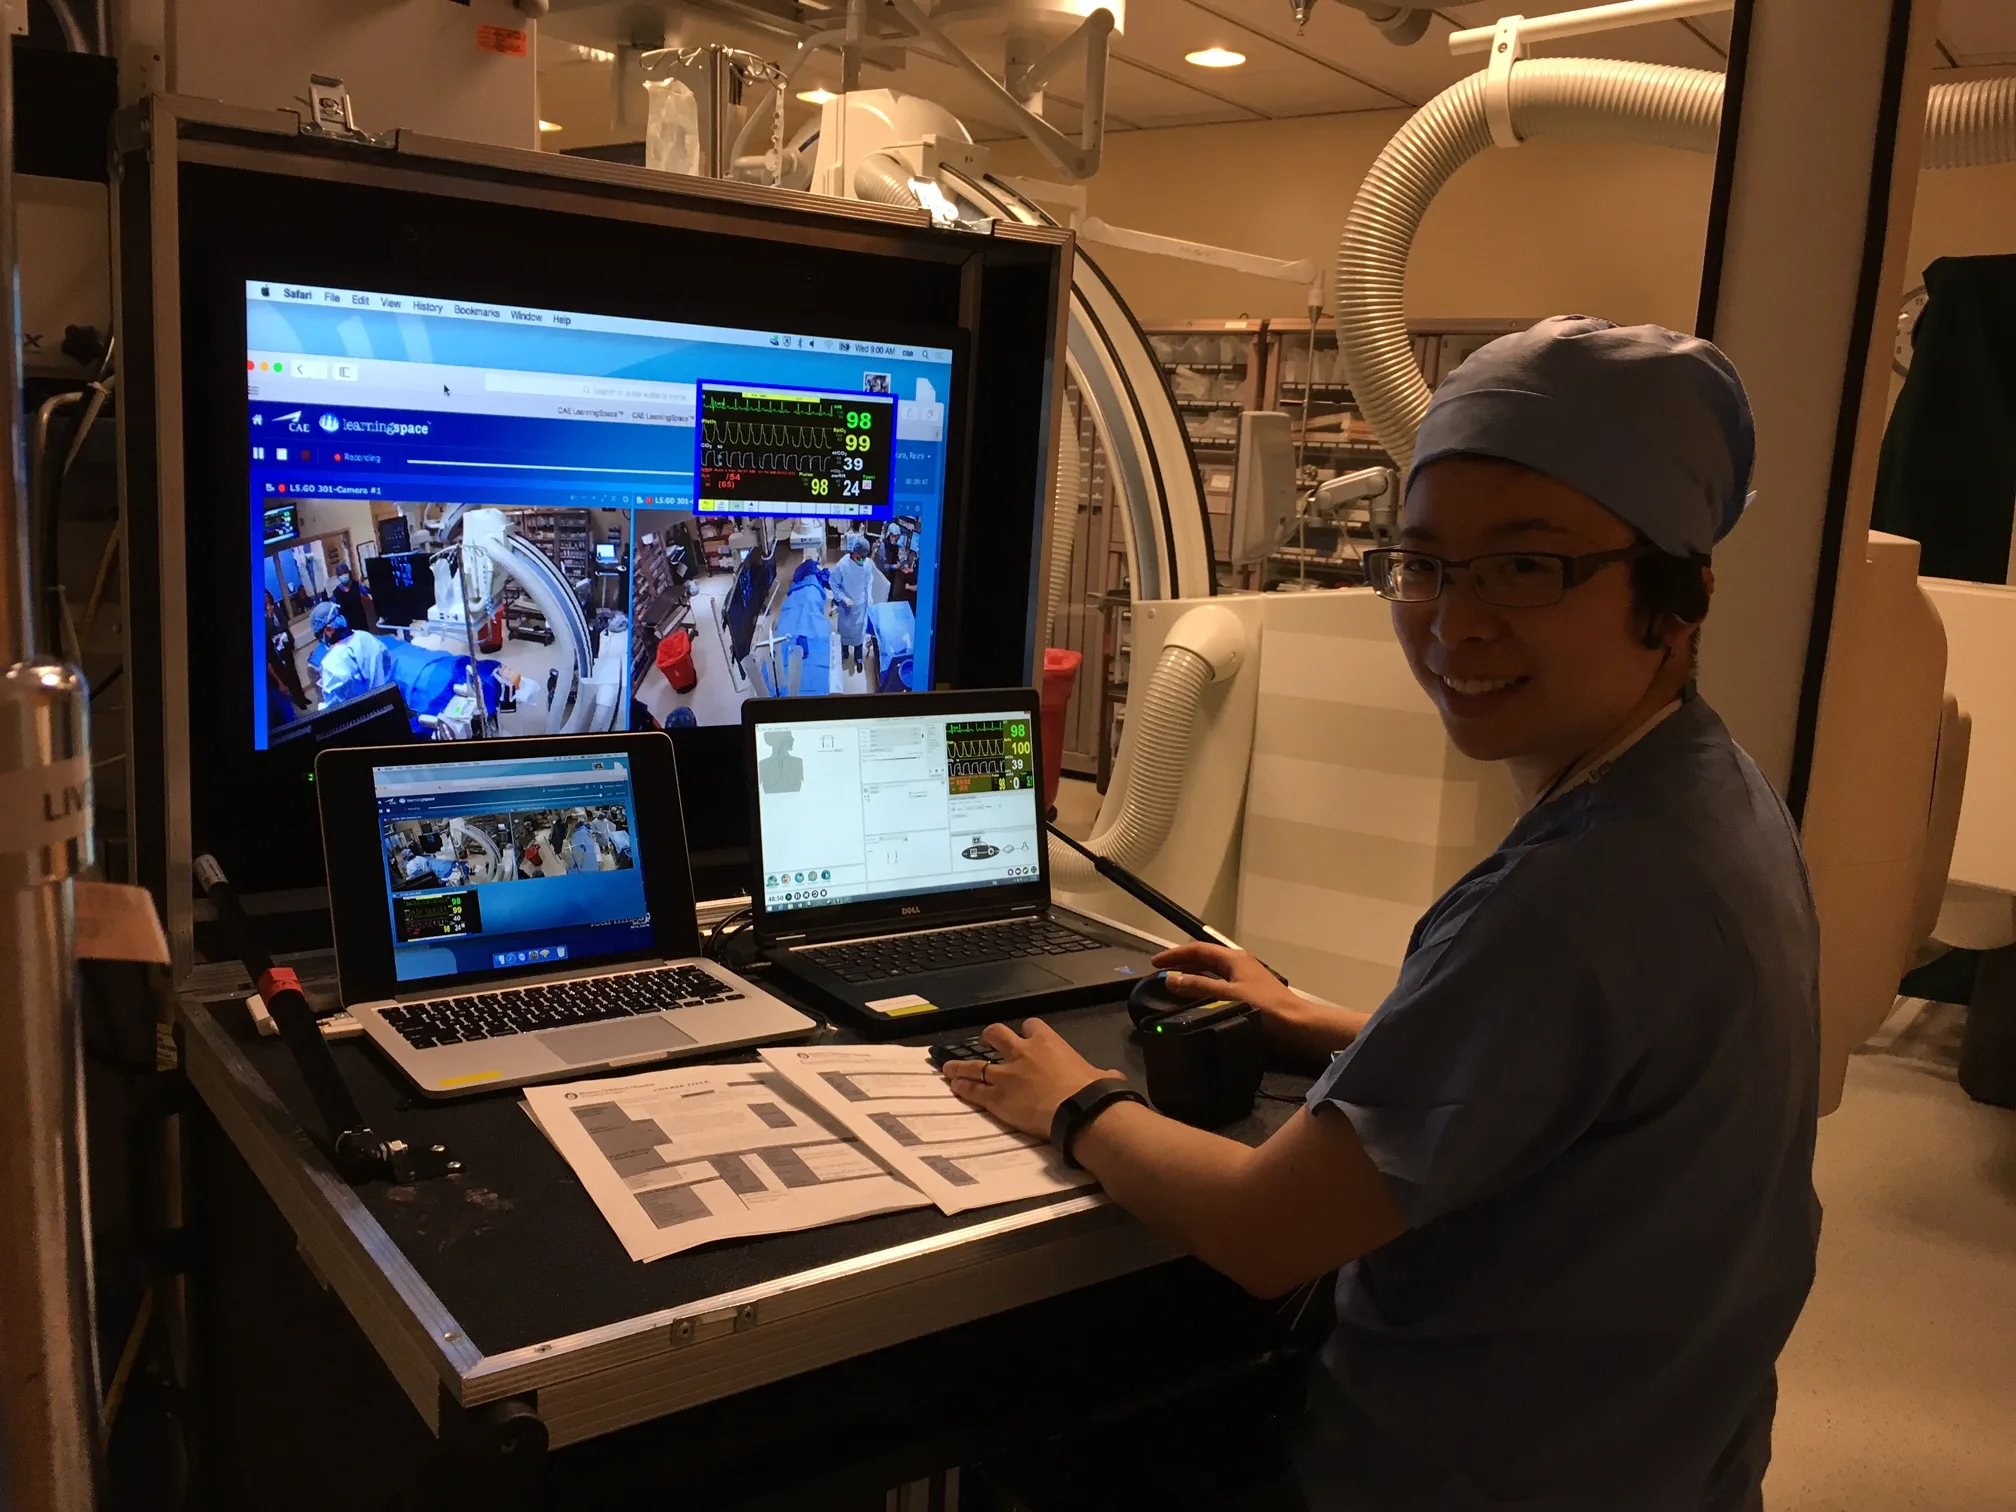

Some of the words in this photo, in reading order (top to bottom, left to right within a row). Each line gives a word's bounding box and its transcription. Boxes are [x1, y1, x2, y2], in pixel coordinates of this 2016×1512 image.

[283, 287, 313, 301] Safari
[324, 291, 341, 303] File
[351, 294, 370, 306] Edit
[380, 297, 401, 309] View
[413, 300, 444, 314] History
[453, 304, 501, 319] Bookmarks
[510, 310, 543, 323] Window
[553, 314, 572, 327] Help
[854, 343, 869, 354] Wed
[885, 348, 896, 356] AM
[557, 406, 572, 415] CAE
[631, 411, 645, 420] CAE
[846, 411, 872, 430] 98
[288, 422, 311, 434] CAE
[845, 434, 871, 452] 99
[344, 452, 382, 465] Recording
[843, 457, 864, 471] 39
[317, 484, 369, 496] 301-Camera
[370, 486, 382, 496] #1
[718, 480, 735, 490] (65)
[811, 478, 829, 496] 98
[842, 480, 860, 497] 24
[1010, 724, 1026, 738] 98
[1011, 741, 1031, 755] 100
[1011, 759, 1024, 770] 39
[451, 897, 462, 906] 98
[901, 906, 921, 916] DELL
